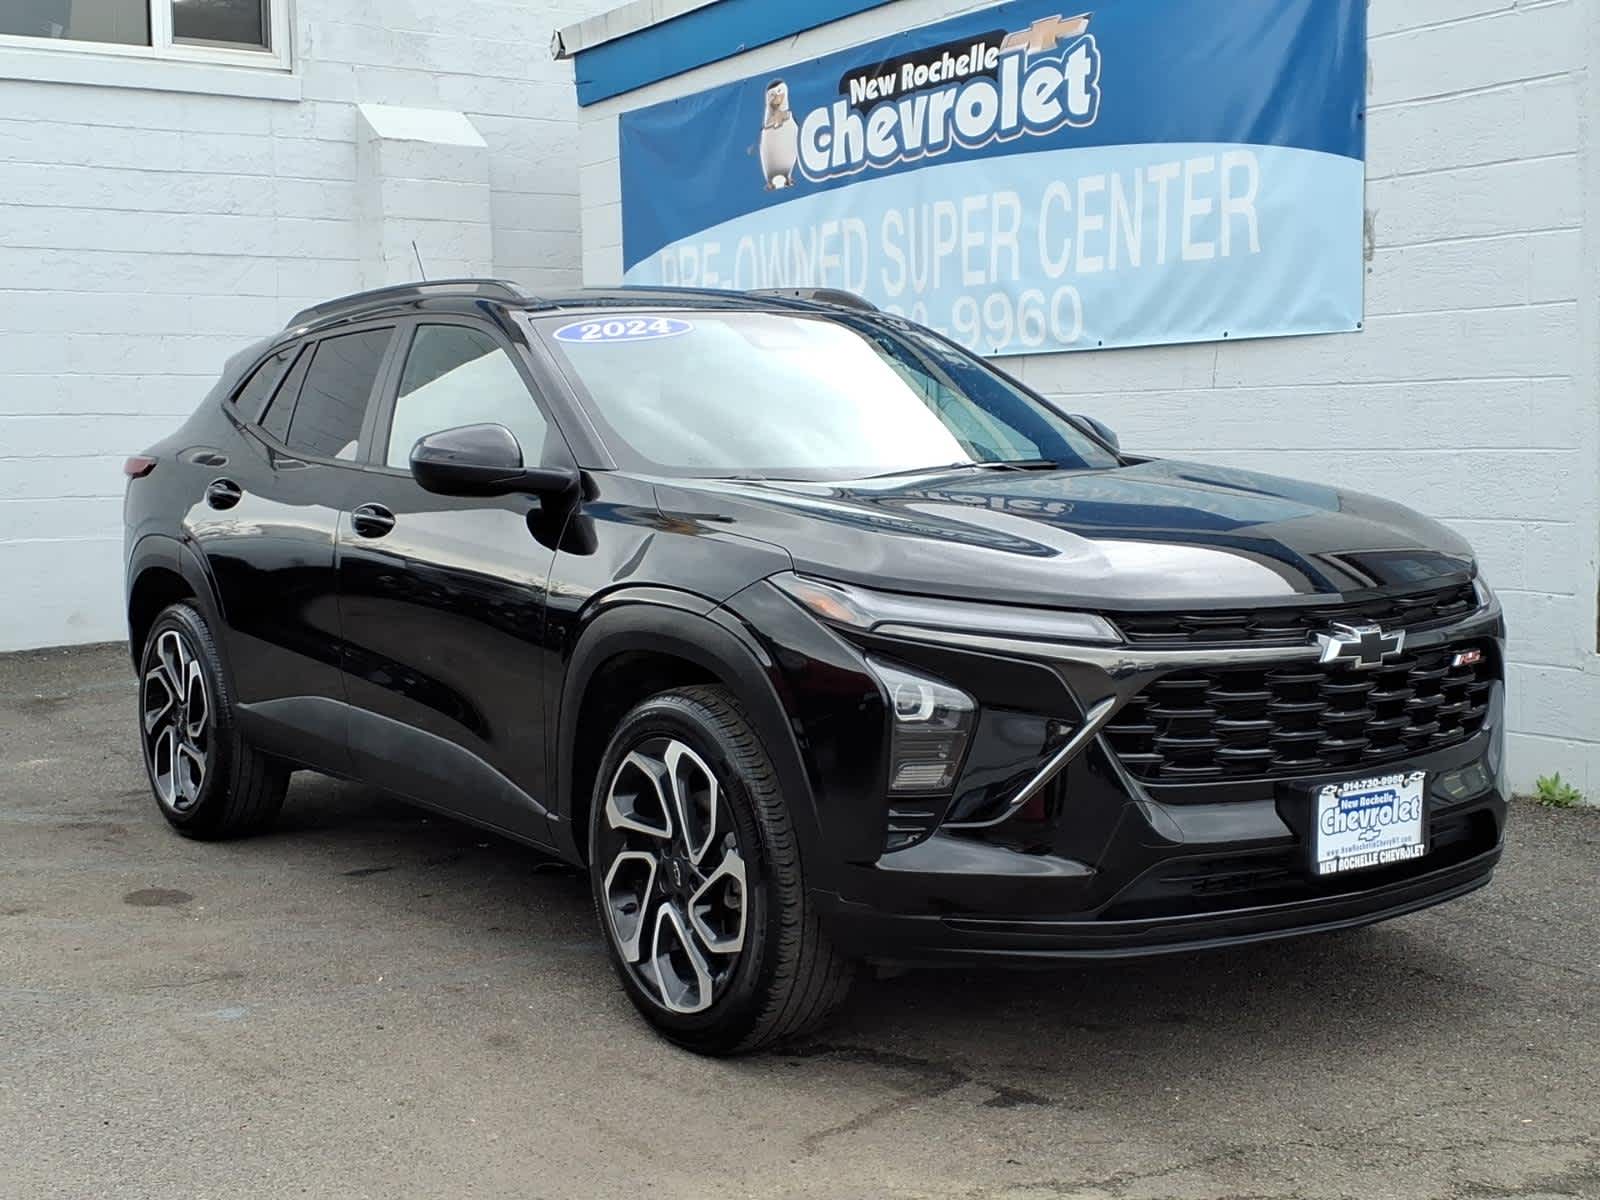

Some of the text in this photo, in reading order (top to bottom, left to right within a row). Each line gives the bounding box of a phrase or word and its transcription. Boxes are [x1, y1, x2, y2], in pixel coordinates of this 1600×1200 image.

[850, 42, 999, 104] New Rochelle
[800, 44, 1091, 172] Chevrolet
[880, 190, 1022, 297] SUPER
[1039, 149, 1262, 279] CENTER
[580, 317, 672, 340] 2024
[1321, 795, 1420, 835] Chevrolet
[1341, 792, 1394, 810] New Rochelle
[1320, 844, 1425, 875] NEW ROCHELLE CHEVROLET
